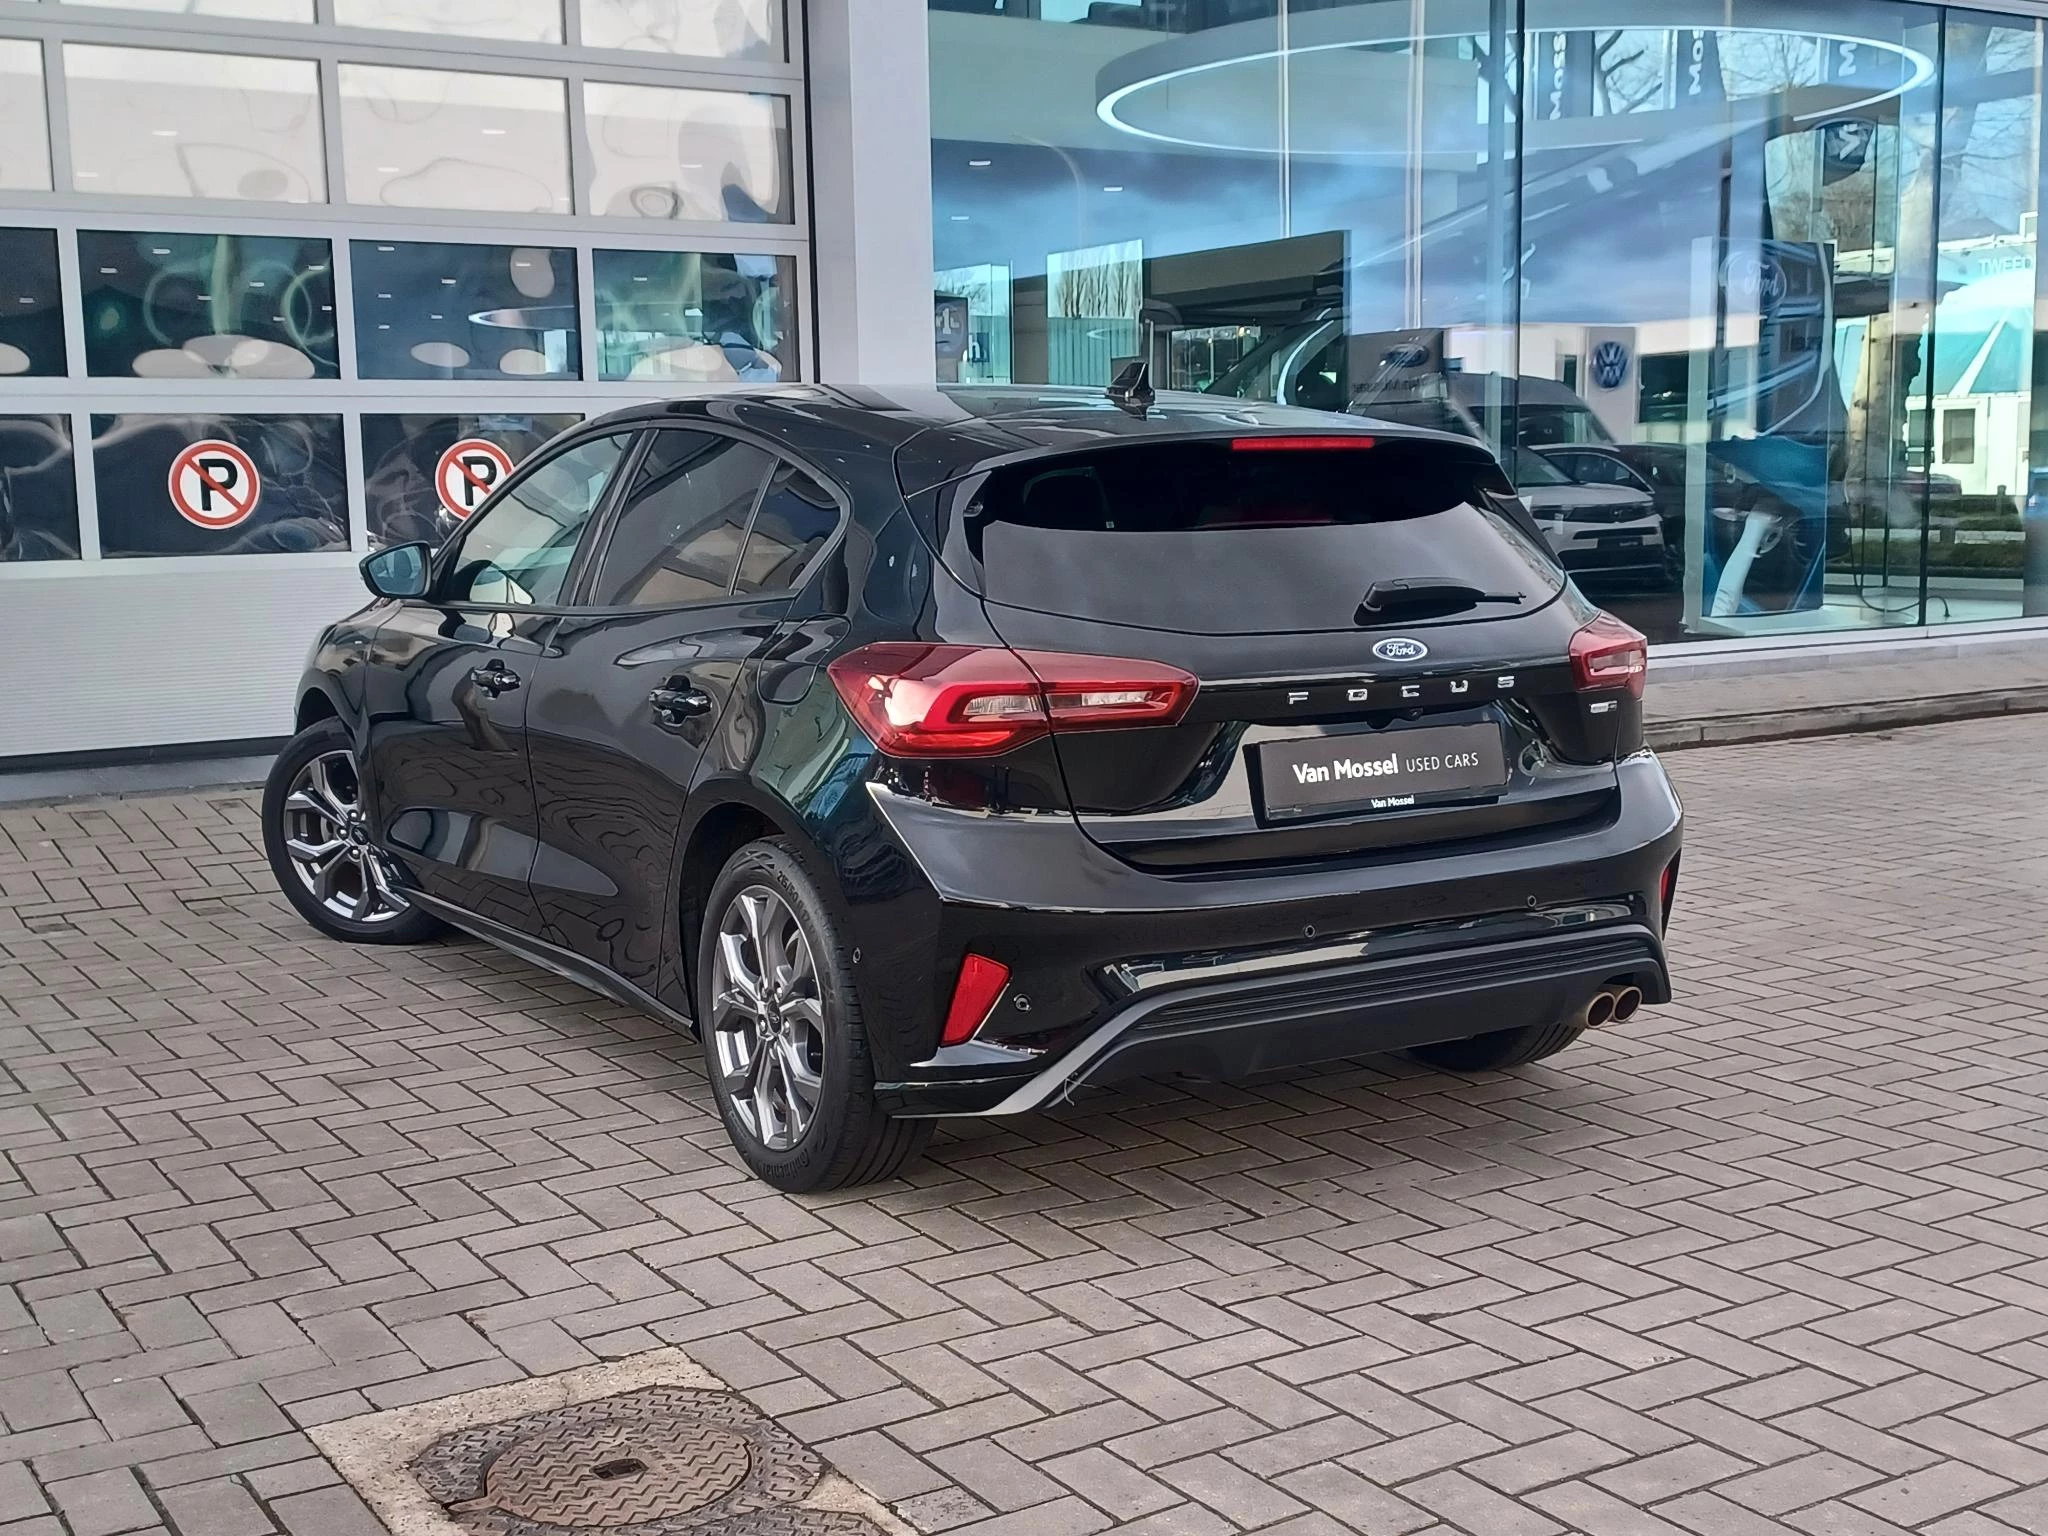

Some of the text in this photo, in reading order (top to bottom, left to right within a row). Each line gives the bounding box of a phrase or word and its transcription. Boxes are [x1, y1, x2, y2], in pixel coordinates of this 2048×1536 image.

[199, 458, 238, 511] P
[462, 455, 498, 506] P
[1386, 642, 1416, 657] Ford
[1288, 675, 1515, 705] FOCUS
[1292, 752, 1480, 784] Van Mossel USED CARS
[1371, 795, 1415, 808] Van Mossel
